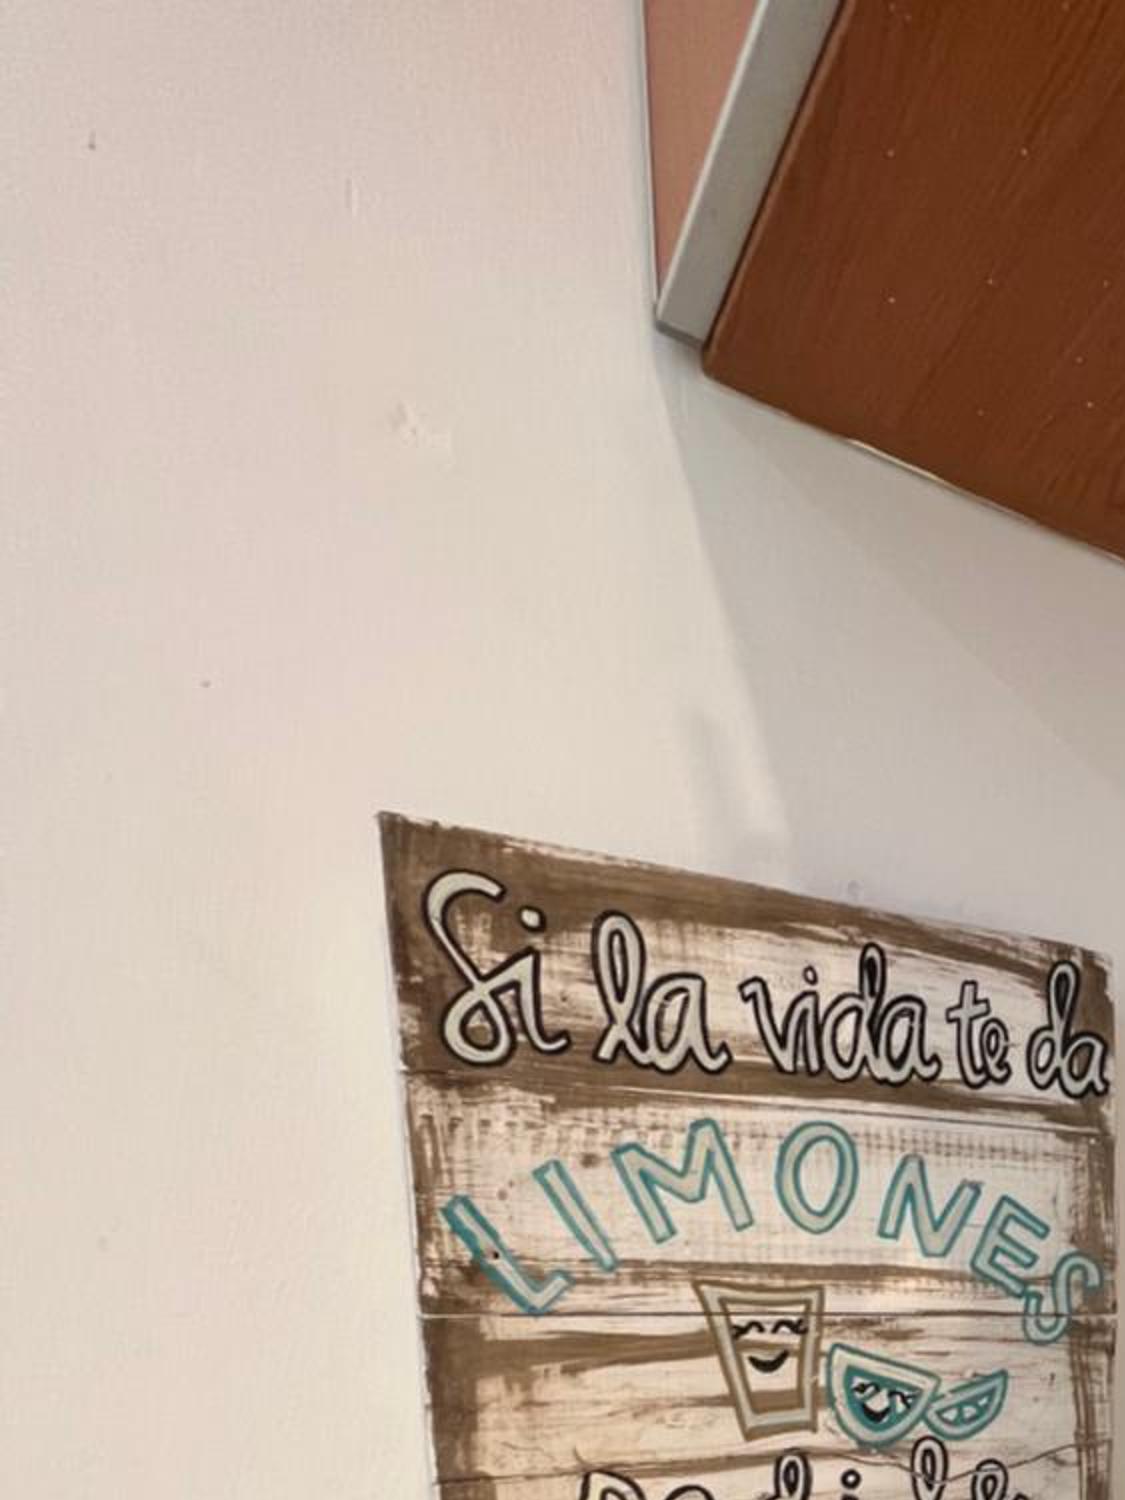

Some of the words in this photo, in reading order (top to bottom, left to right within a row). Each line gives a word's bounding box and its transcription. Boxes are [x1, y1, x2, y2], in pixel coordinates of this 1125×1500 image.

[421, 868, 570, 1067] Si
[591, 910, 731, 1075] la
[740, 942, 940, 1085] vida
[946, 980, 1011, 1089] te
[1025, 959, 1109, 1098] da
[440, 1117, 1103, 1345] LIMONES
